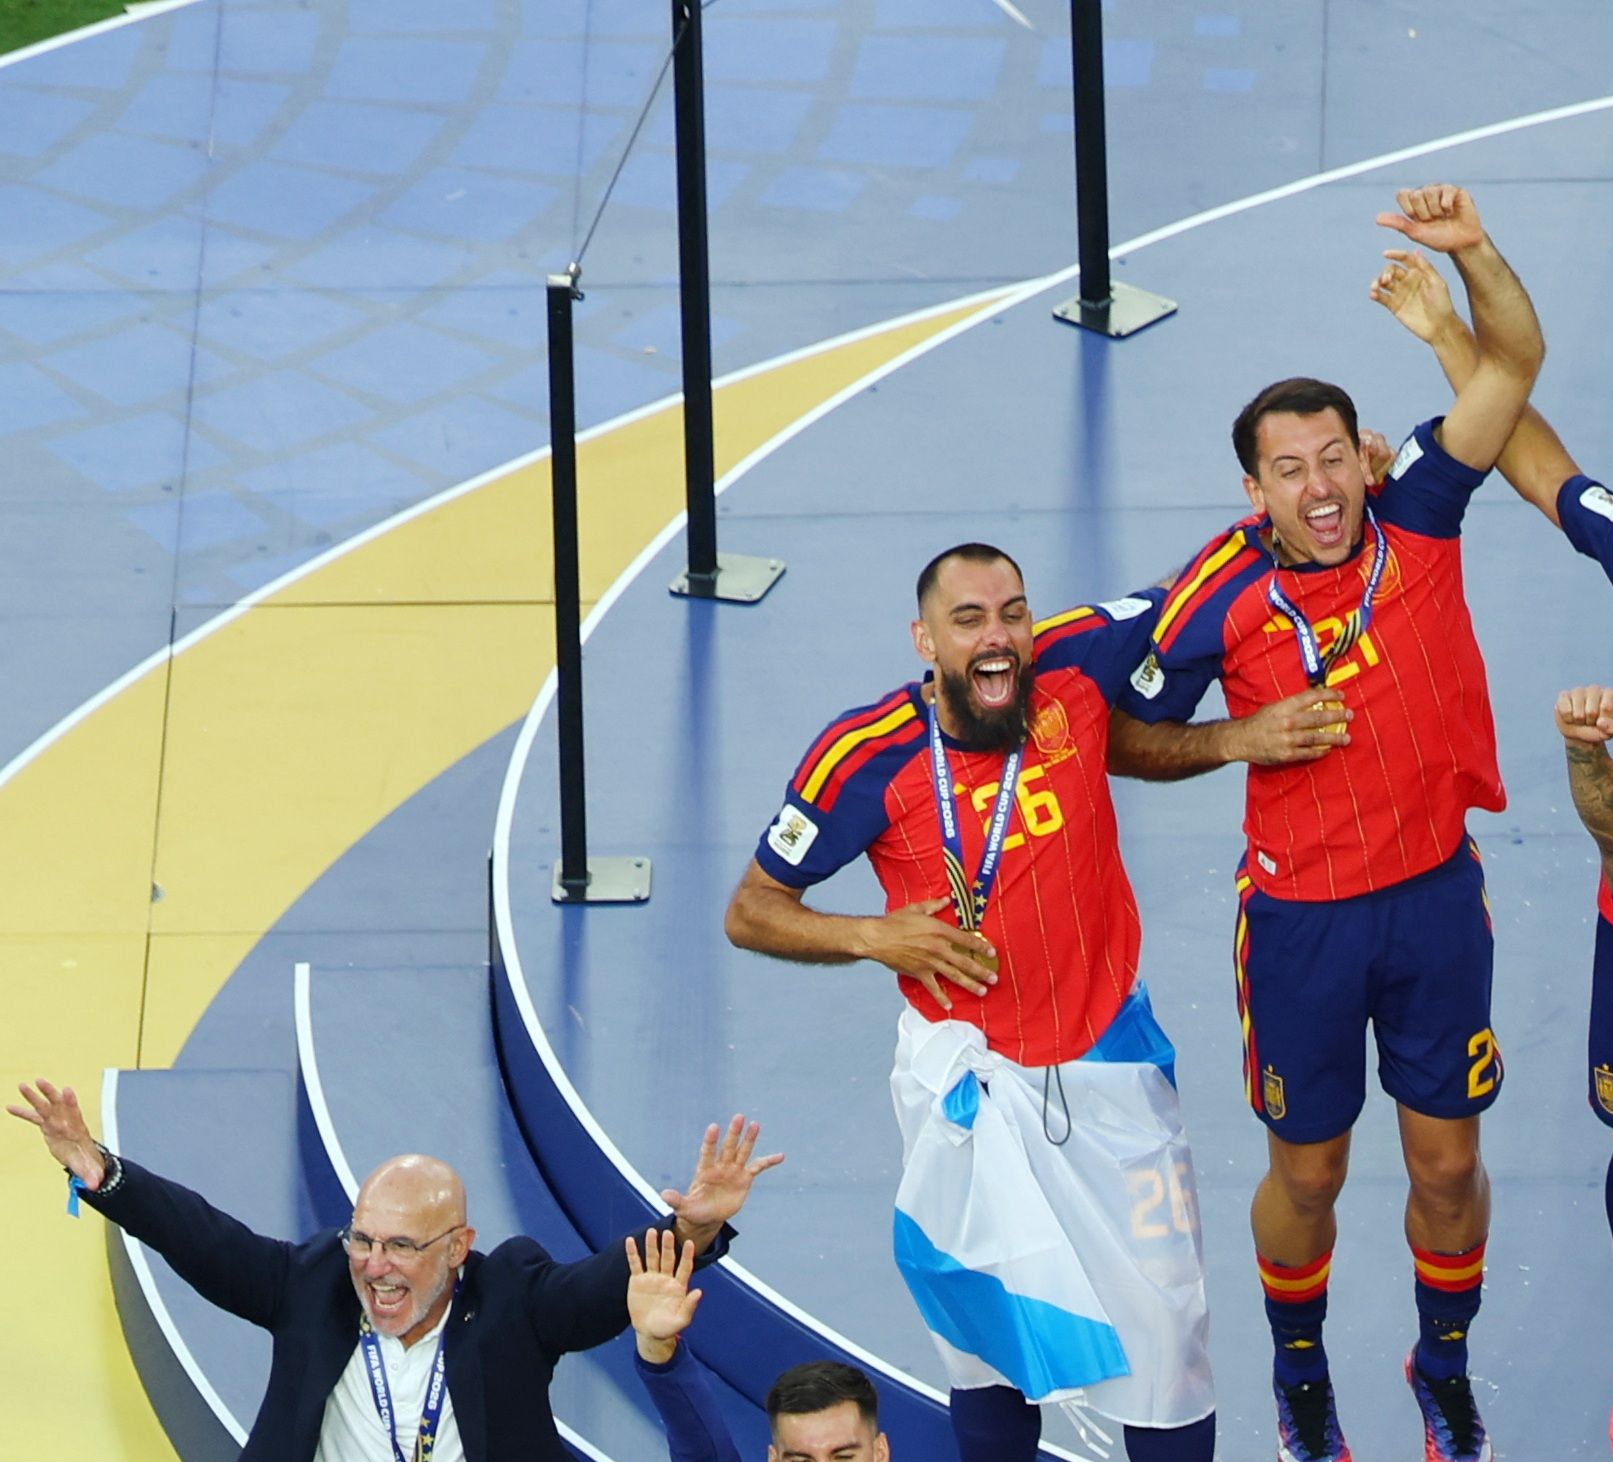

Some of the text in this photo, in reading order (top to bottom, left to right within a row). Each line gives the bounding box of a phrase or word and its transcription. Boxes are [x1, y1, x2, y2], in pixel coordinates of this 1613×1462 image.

[1364, 586, 1373, 608] FIFA
[1370, 549, 1384, 586] WORLD
[1269, 587, 1318, 673] WORLD CUP 2026
[934, 738, 955, 839] WORLD CUP 2026
[972, 764, 1066, 851] 26
[982, 753, 1018, 875] FIFA WORLD CUP 2026
[367, 1345, 381, 1370] FIFA
[372, 1367, 388, 1408] WORLD
[427, 1371, 443, 1410] 2026
